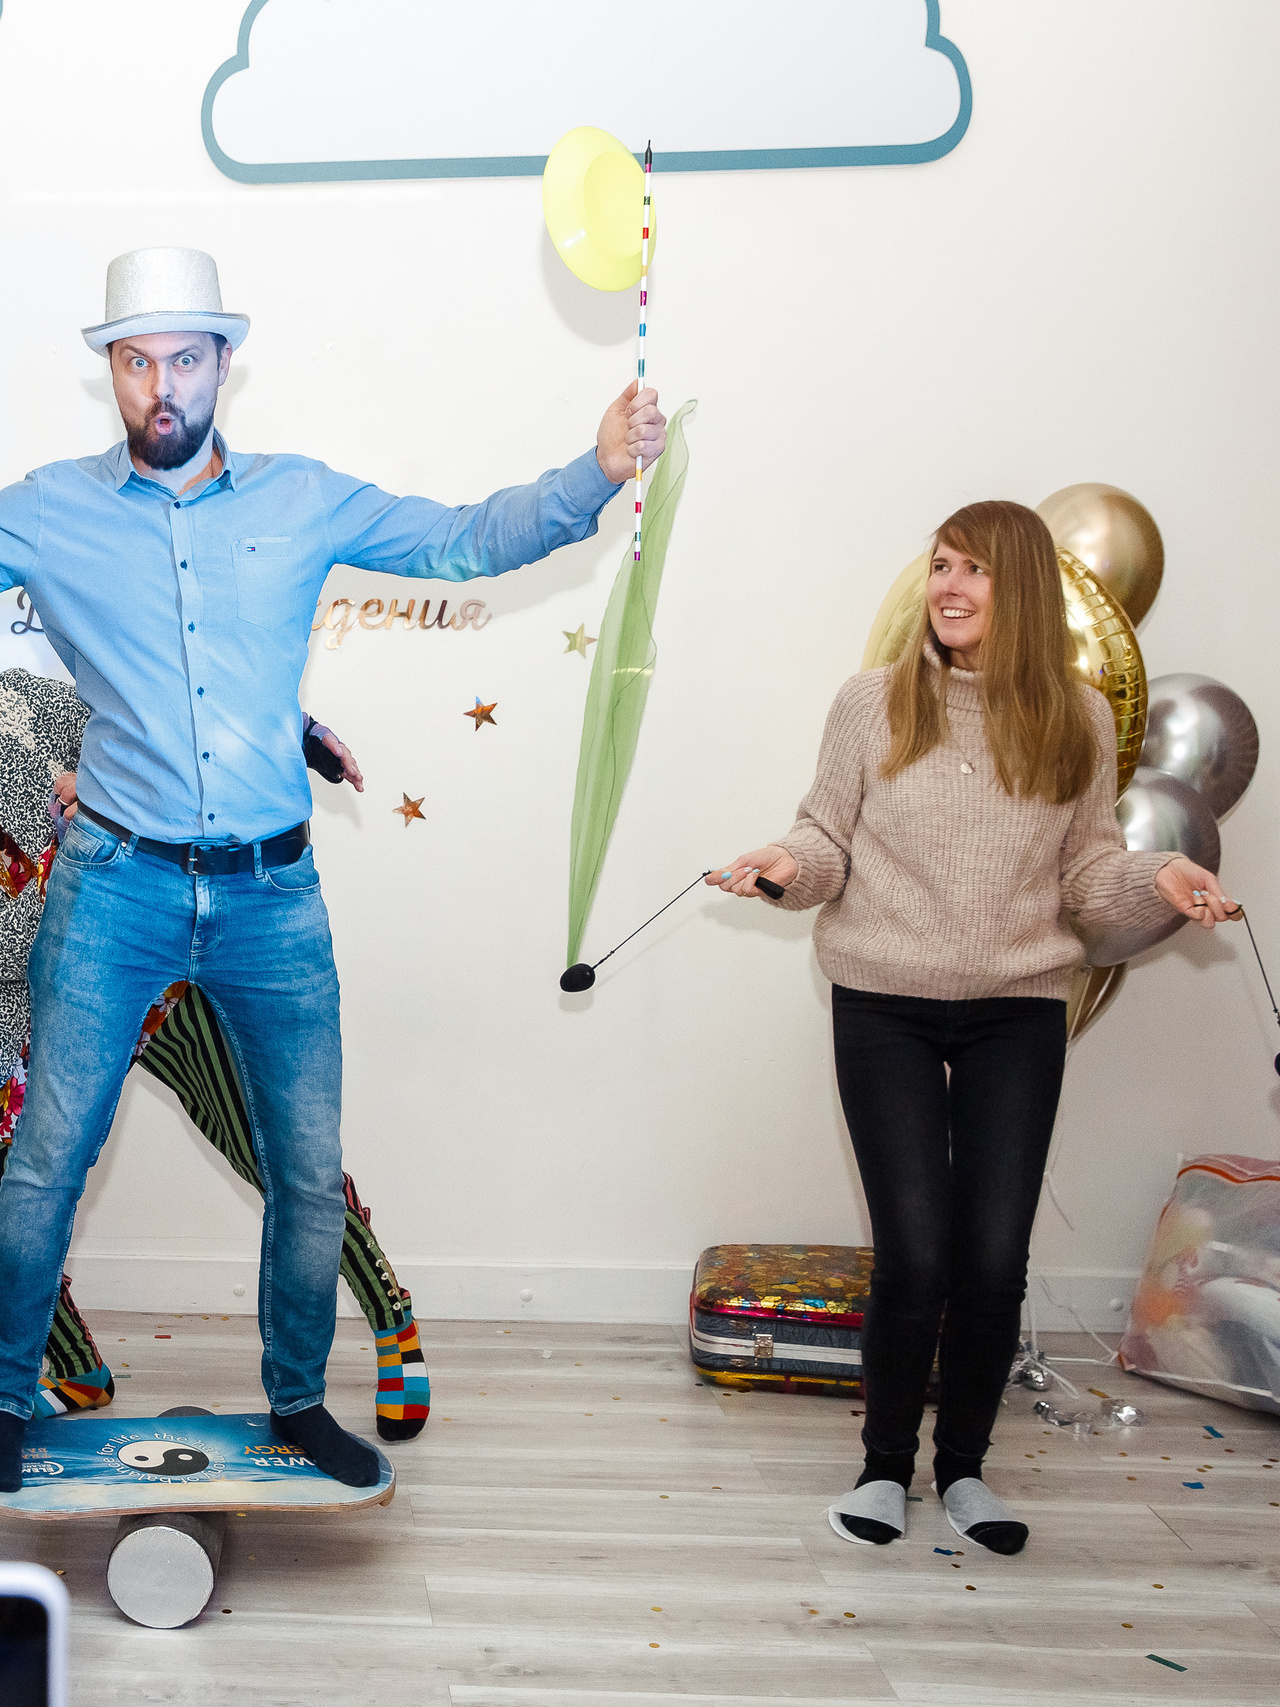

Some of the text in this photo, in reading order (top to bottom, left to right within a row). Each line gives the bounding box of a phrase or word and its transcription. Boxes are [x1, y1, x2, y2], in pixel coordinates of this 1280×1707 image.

[96, 1432, 226, 1485] the harmony of balance for life
[250, 1457, 316, 1467] WER
